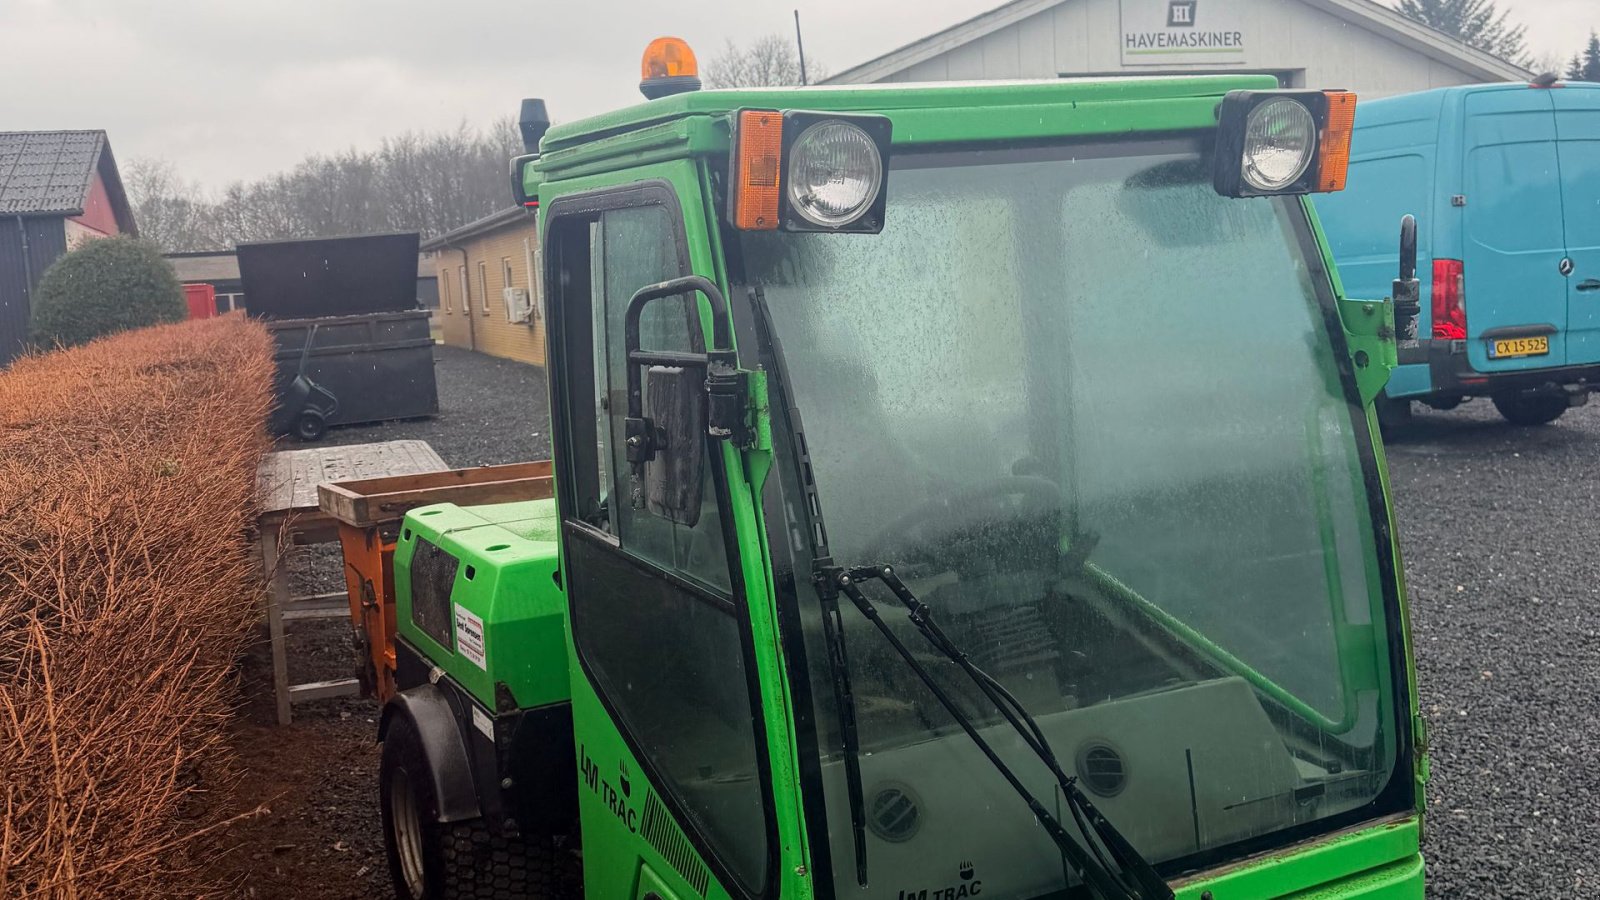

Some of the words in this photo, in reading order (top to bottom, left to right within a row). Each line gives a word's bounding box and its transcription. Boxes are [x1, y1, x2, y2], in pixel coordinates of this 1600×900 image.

[1125, 31, 1243, 48] HAVEMASKINER
[1496, 341, 1511, 354] CX
[1513, 340, 1526, 352] 15
[1527, 338, 1547, 351] 525
[580, 743, 599, 794] LM
[602, 779, 637, 834] TRAC
[932, 880, 982, 900] TRAC
